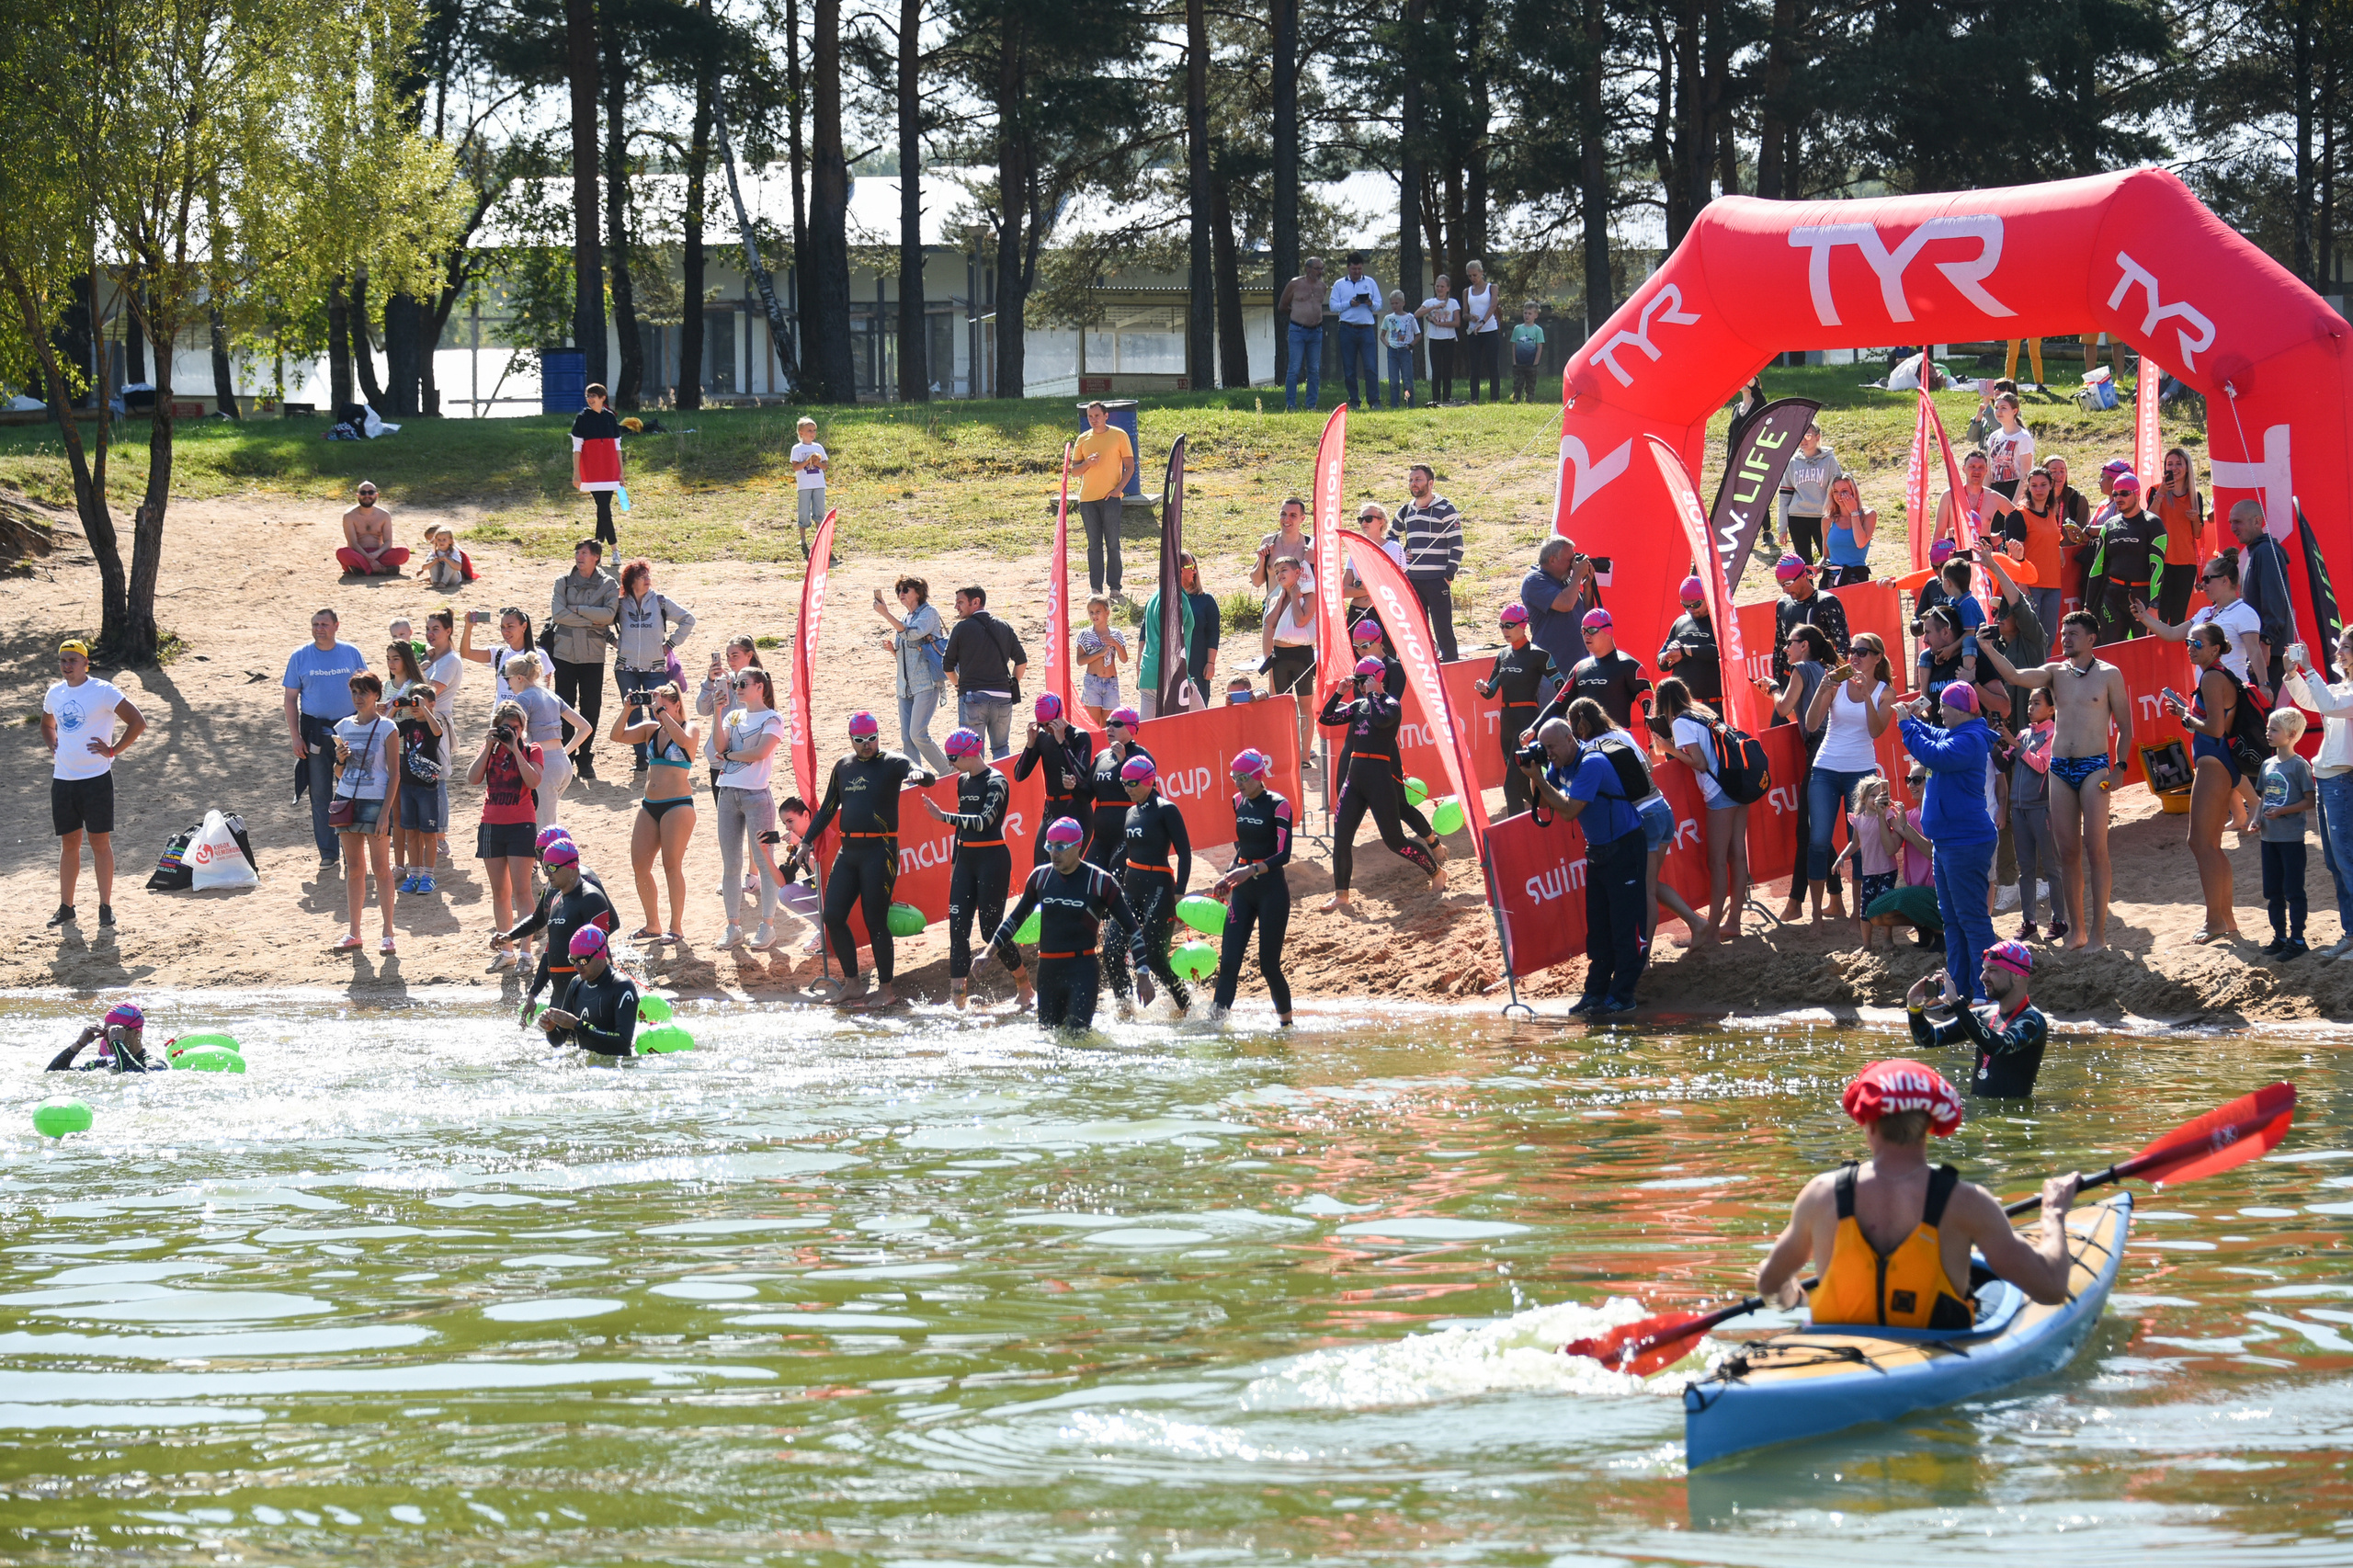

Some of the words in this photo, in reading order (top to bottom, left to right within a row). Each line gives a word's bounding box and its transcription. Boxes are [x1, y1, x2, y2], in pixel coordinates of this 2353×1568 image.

[1788, 213, 2019, 327] TYR
[2107, 250, 2216, 374] TYR
[1589, 283, 1701, 388] TYR
[1795, 468, 1824, 488] CHARM
[1677, 631, 1711, 639] orca
[309, 666, 351, 676] #sberbank
[1577, 677, 1608, 687] orca
[2138, 693, 2166, 722] TY
[1096, 771, 1112, 781] TYR
[844, 784, 867, 792] sailfish
[1236, 816, 1264, 825] orca
[1126, 827, 1142, 838] TYR
[1525, 858, 1587, 906] swim
[1042, 897, 1085, 908] orca
[585, 928, 607, 941] TY
[1877, 1070, 1930, 1093] RUN
